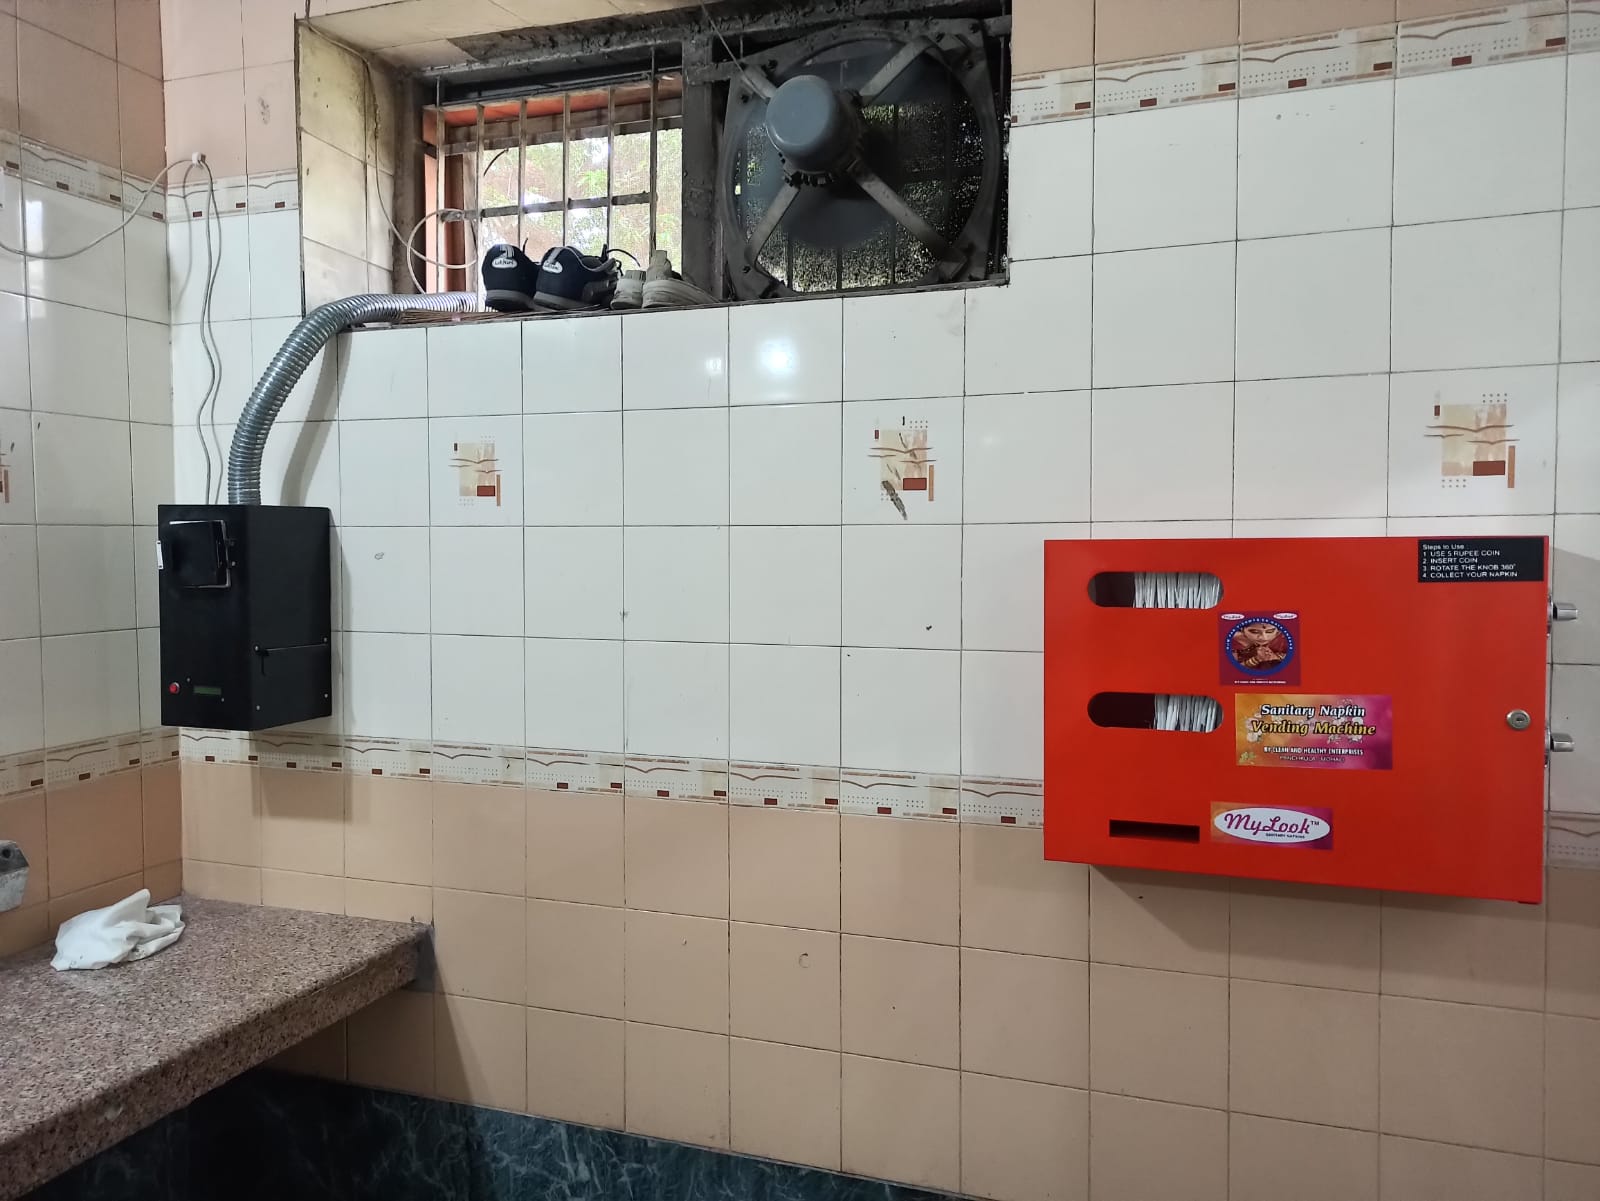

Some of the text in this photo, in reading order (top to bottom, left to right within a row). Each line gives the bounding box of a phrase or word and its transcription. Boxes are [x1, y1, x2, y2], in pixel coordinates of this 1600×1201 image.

[1261, 704, 1366, 719] Sanitary Napkin
[1251, 720, 1376, 736] Vending Machine
[1224, 814, 1310, 835] MyLook
